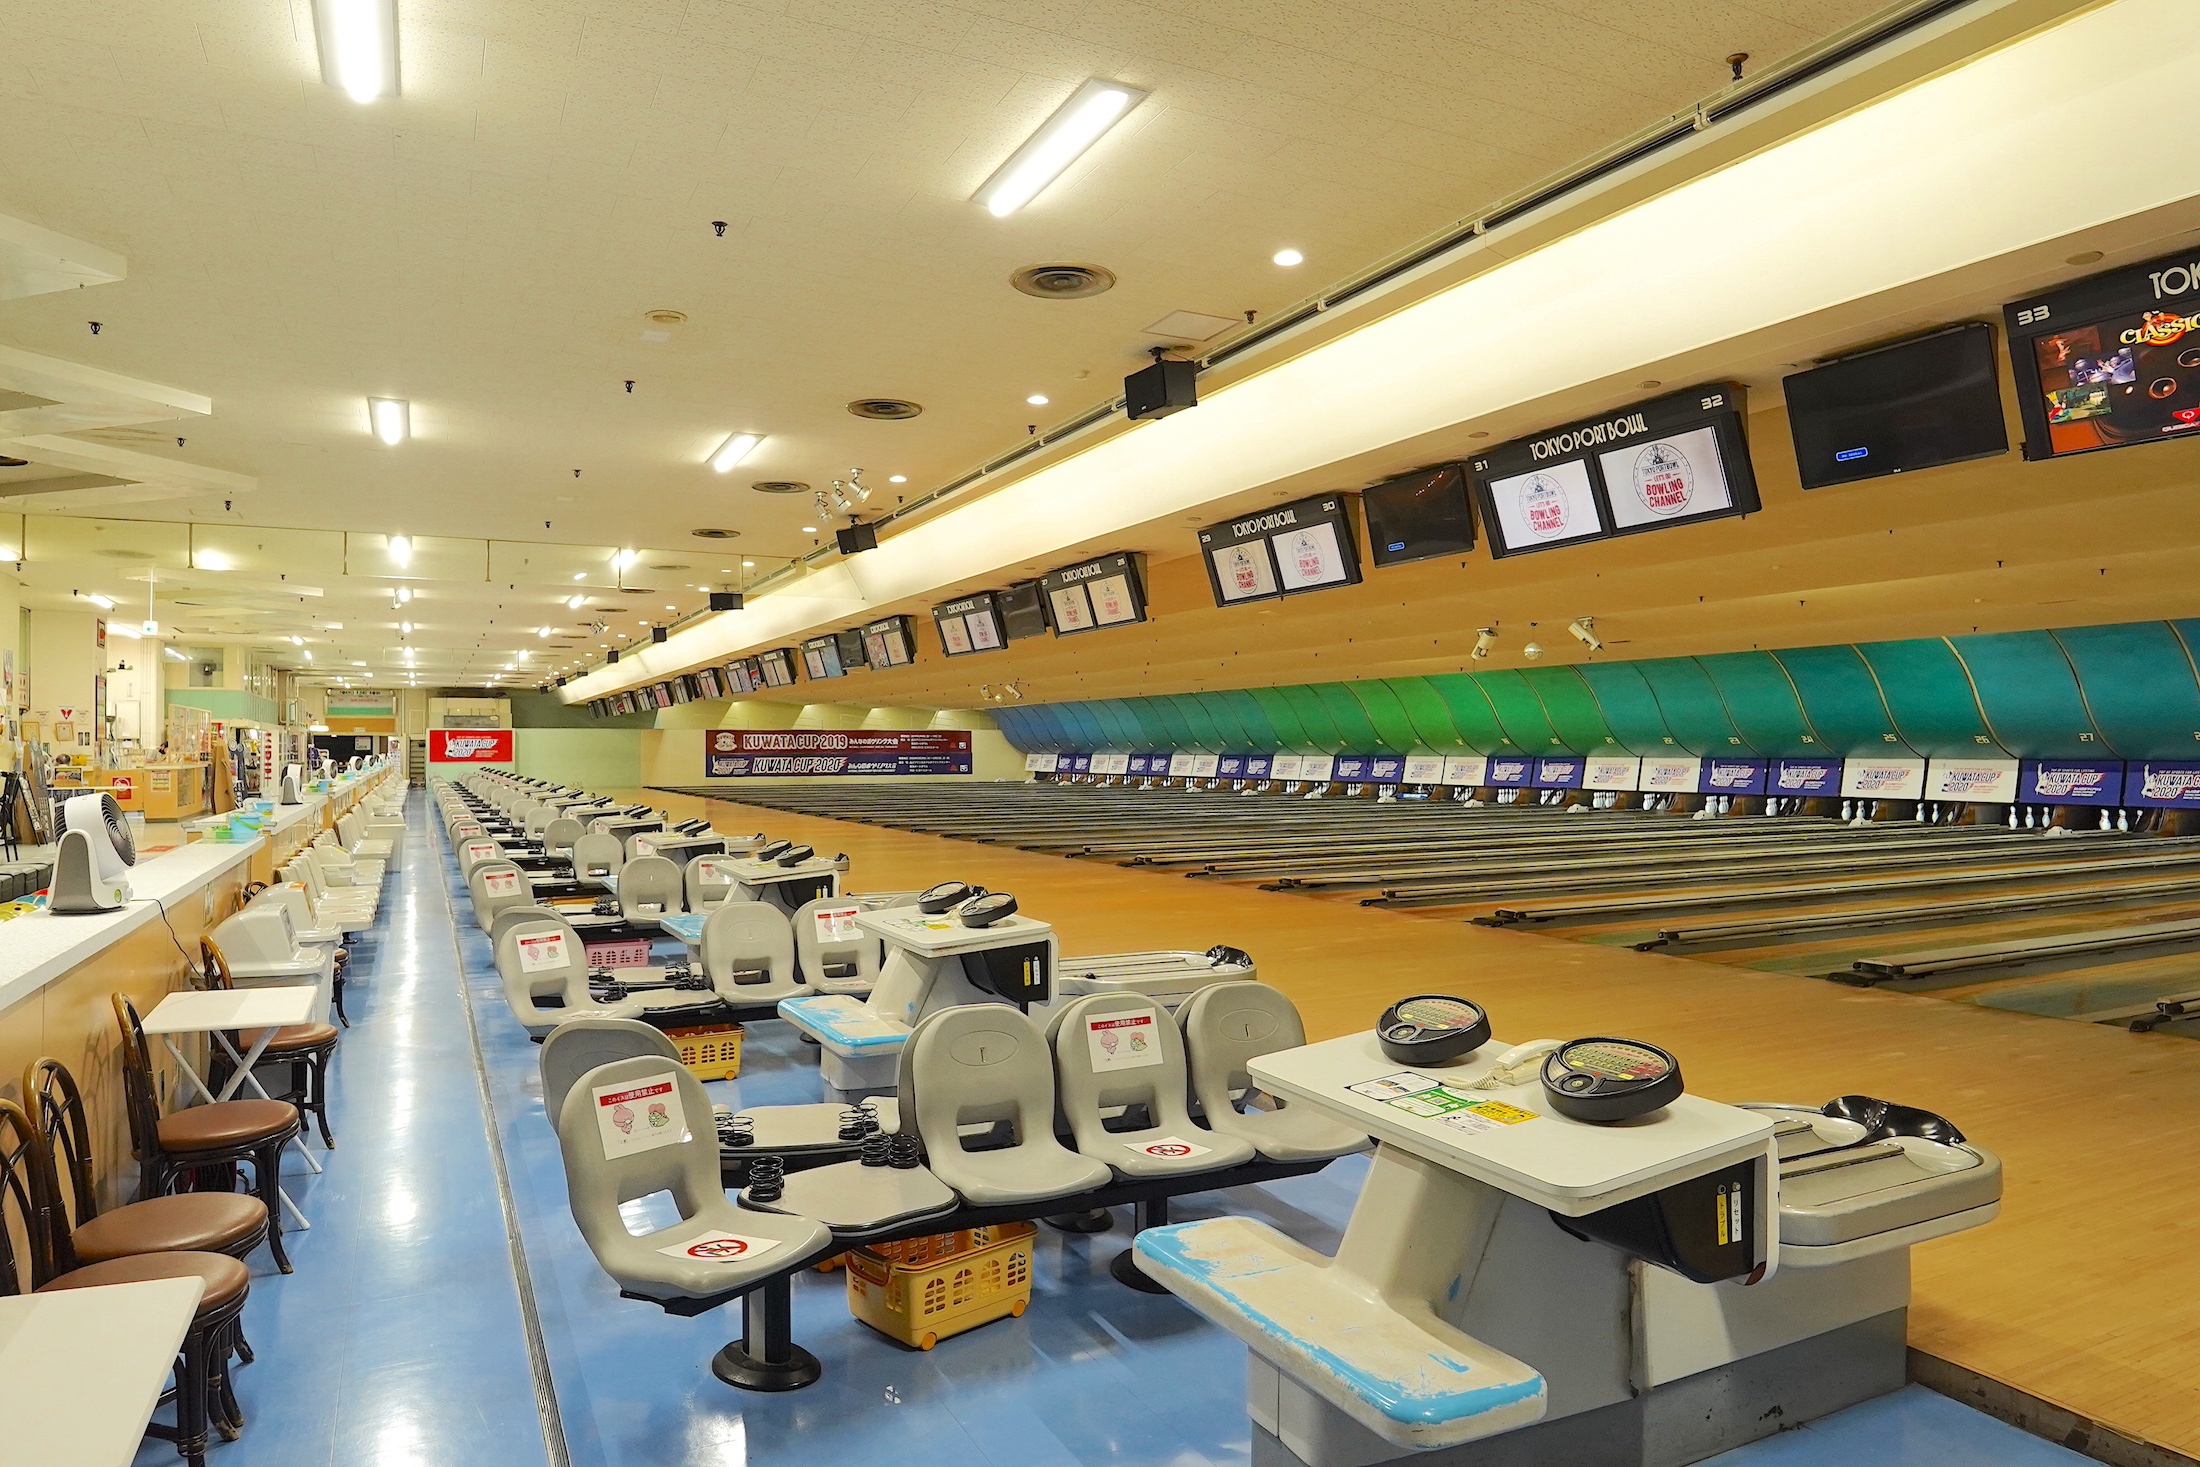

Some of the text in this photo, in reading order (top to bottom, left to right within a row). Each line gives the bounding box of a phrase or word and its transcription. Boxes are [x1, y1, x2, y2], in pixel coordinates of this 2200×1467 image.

[2017, 305, 2050, 326] 33
[1701, 394, 1724, 410] 32
[1529, 412, 1649, 461] TOKYO PORT BOWL
[1474, 459, 1489, 472] 31
[1646, 477, 1684, 496] BOWLING
[1649, 491, 1687, 508] CHANNEL
[1322, 501, 1335, 512] 30
[1530, 504, 1561, 520] BOWLING
[1231, 518, 1256, 538] TOKYO
[1533, 516, 1564, 531] CHANNEL
[1201, 534, 1211, 543] 29
[456, 739, 481, 748] KUWATA
[743, 734, 796, 750] KUWATA
[797, 734, 820, 750] CUP
[820, 734, 847, 750] 2019
[1883, 734, 1897, 742] 25
[1974, 735, 1990, 744] 26
[2079, 733, 2094, 742] 27
[752, 757, 794, 774] KUWATA
[794, 757, 815, 773] CUP
[813, 757, 842, 773] 2020
[1951, 772, 1997, 782] KUWATA CUP
[2048, 773, 2099, 785] KUWATA CUP
[2156, 774, 2193, 788] KUWATA
[1949, 782, 1969, 791] 2020
[2045, 784, 2068, 794] 2020
[2153, 786, 2178, 798] 2020
[608, 1086, 664, 1104] このイスは使用禁止です
